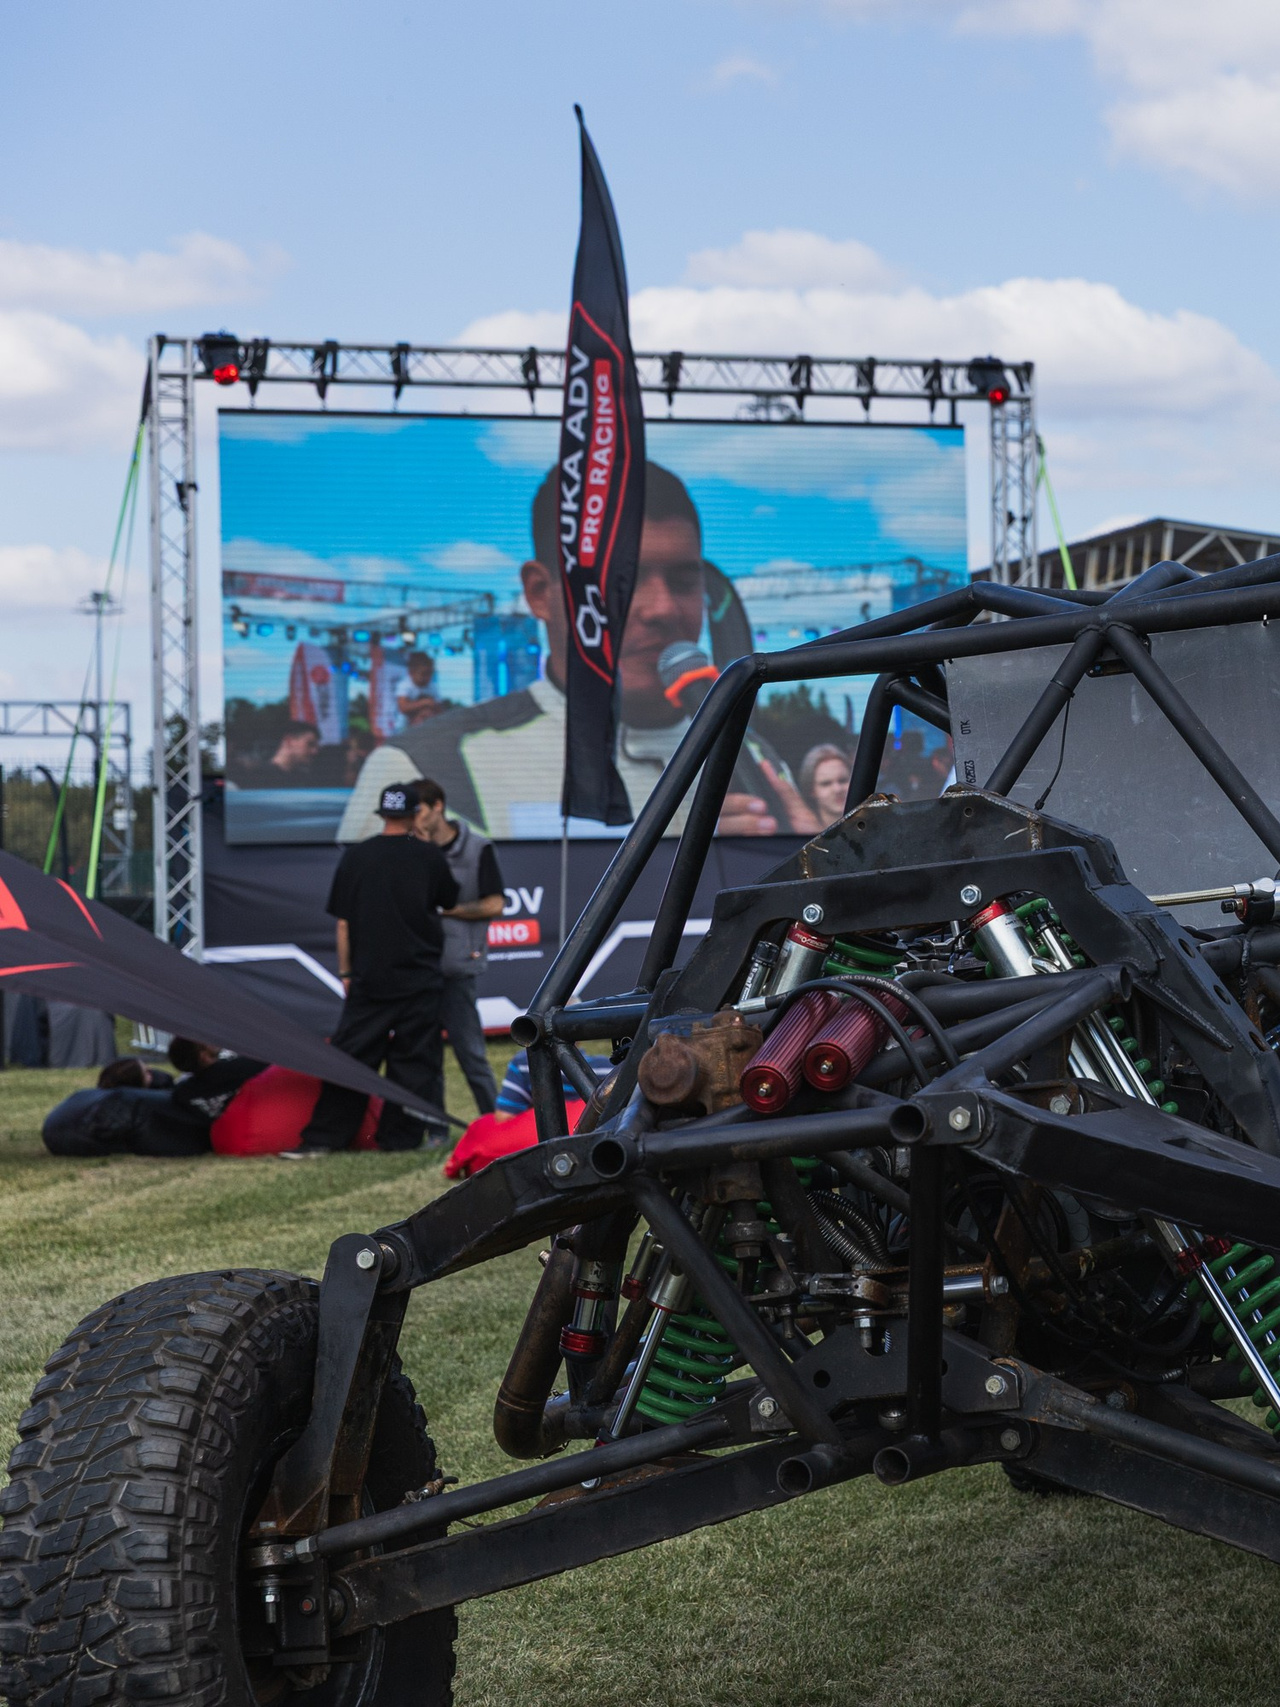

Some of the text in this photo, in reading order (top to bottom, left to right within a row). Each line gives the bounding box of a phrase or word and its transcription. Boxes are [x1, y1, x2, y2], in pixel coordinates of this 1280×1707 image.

[560, 344, 590, 574] YUKA ADV
[581, 373, 614, 553] PRO RACING
[502, 886, 544, 916] DV
